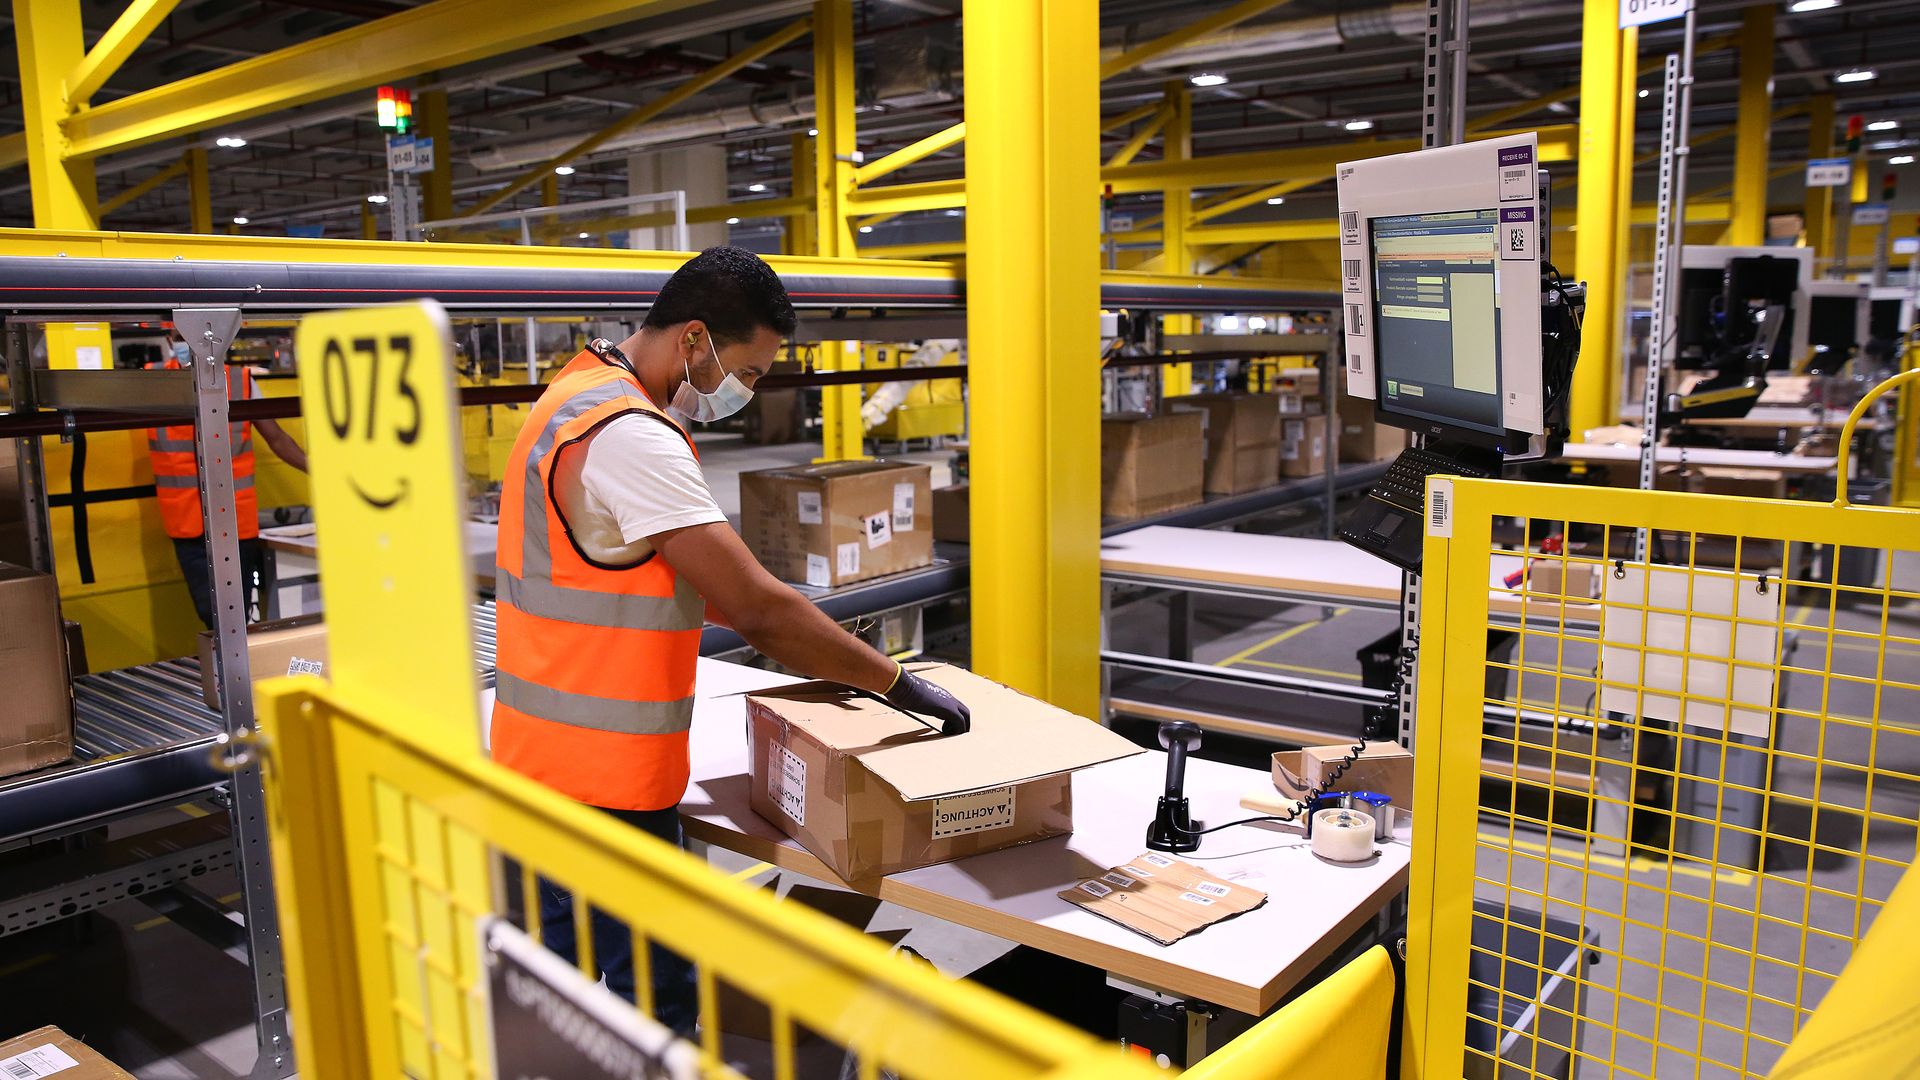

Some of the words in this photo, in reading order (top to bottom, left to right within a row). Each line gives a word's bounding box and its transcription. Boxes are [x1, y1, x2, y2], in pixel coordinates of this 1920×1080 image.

[1507, 211, 1526, 219] MISSING
[322, 335, 421, 445] 073
[1431, 426, 1442, 434] acer
[941, 806, 994, 823] ACHTUNG
